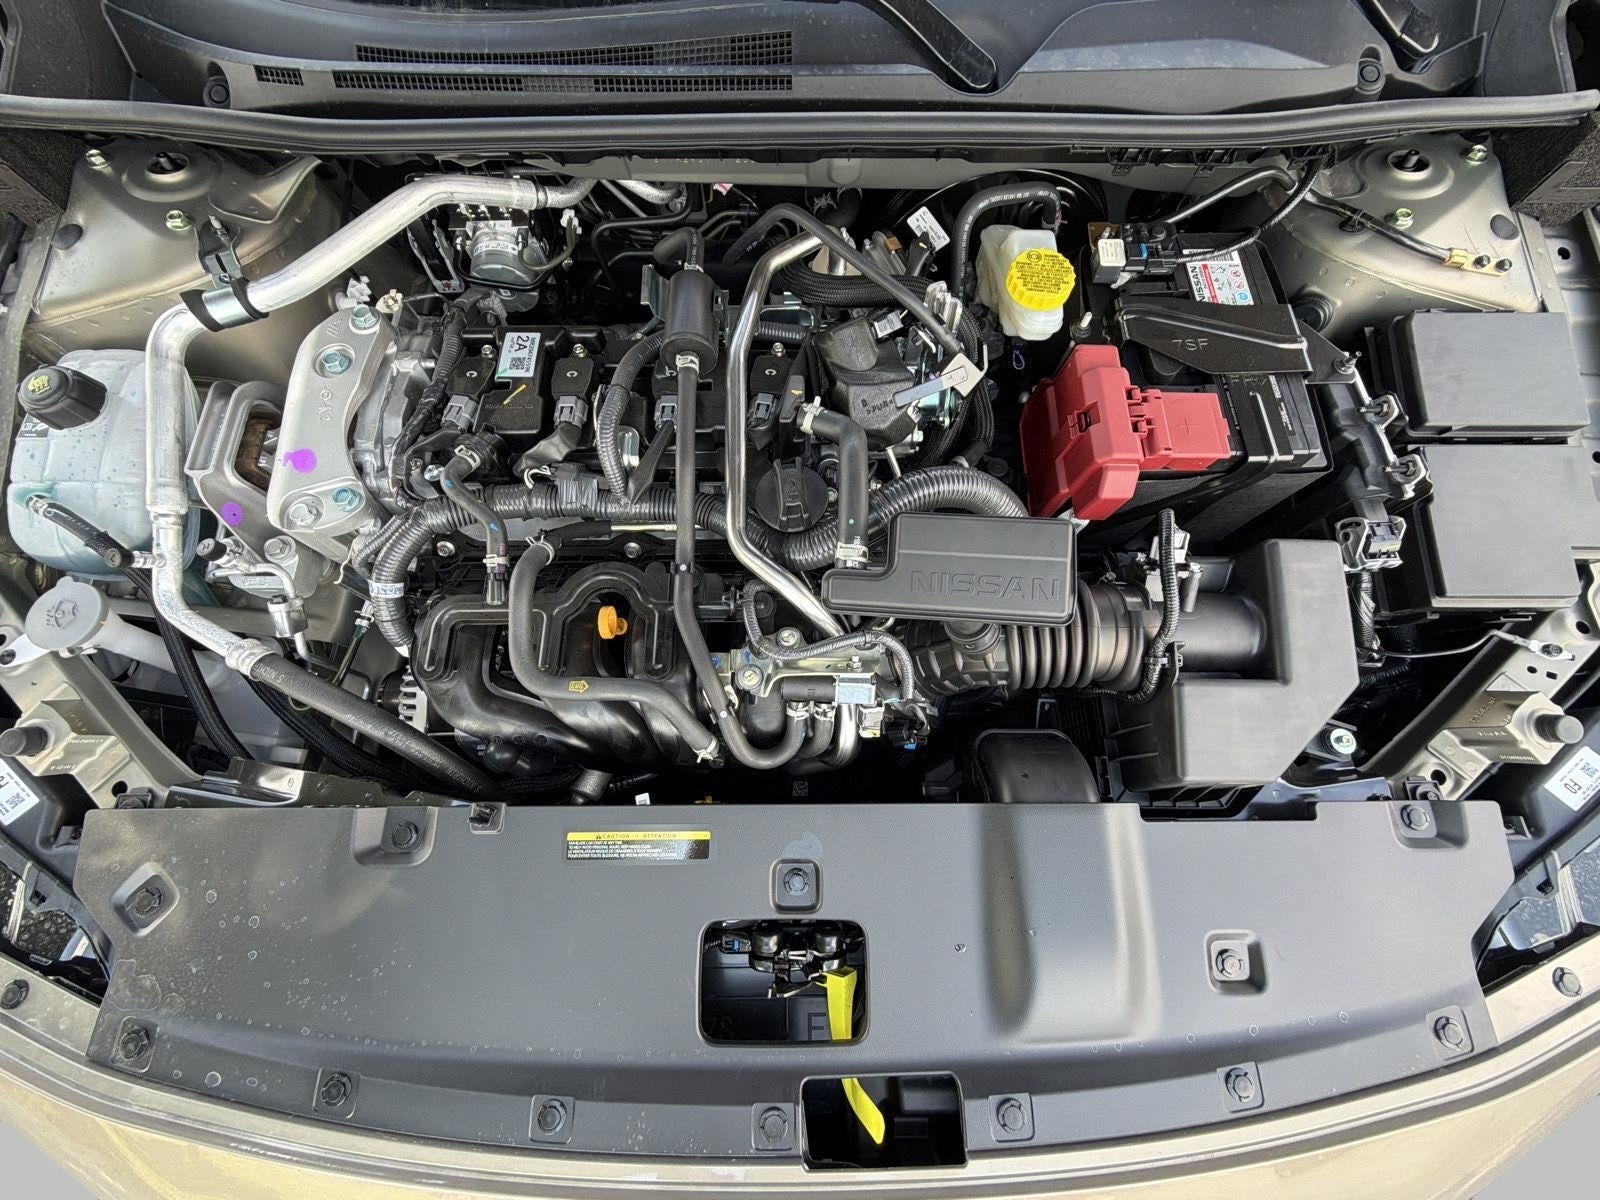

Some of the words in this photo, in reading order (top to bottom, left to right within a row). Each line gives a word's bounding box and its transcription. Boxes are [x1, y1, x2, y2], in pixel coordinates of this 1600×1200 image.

[1190, 265, 1207, 302] NISSAN
[515, 335, 530, 352] 2A
[1172, 338, 1208, 351] 7SF
[911, 571, 1061, 601] NISSAN
